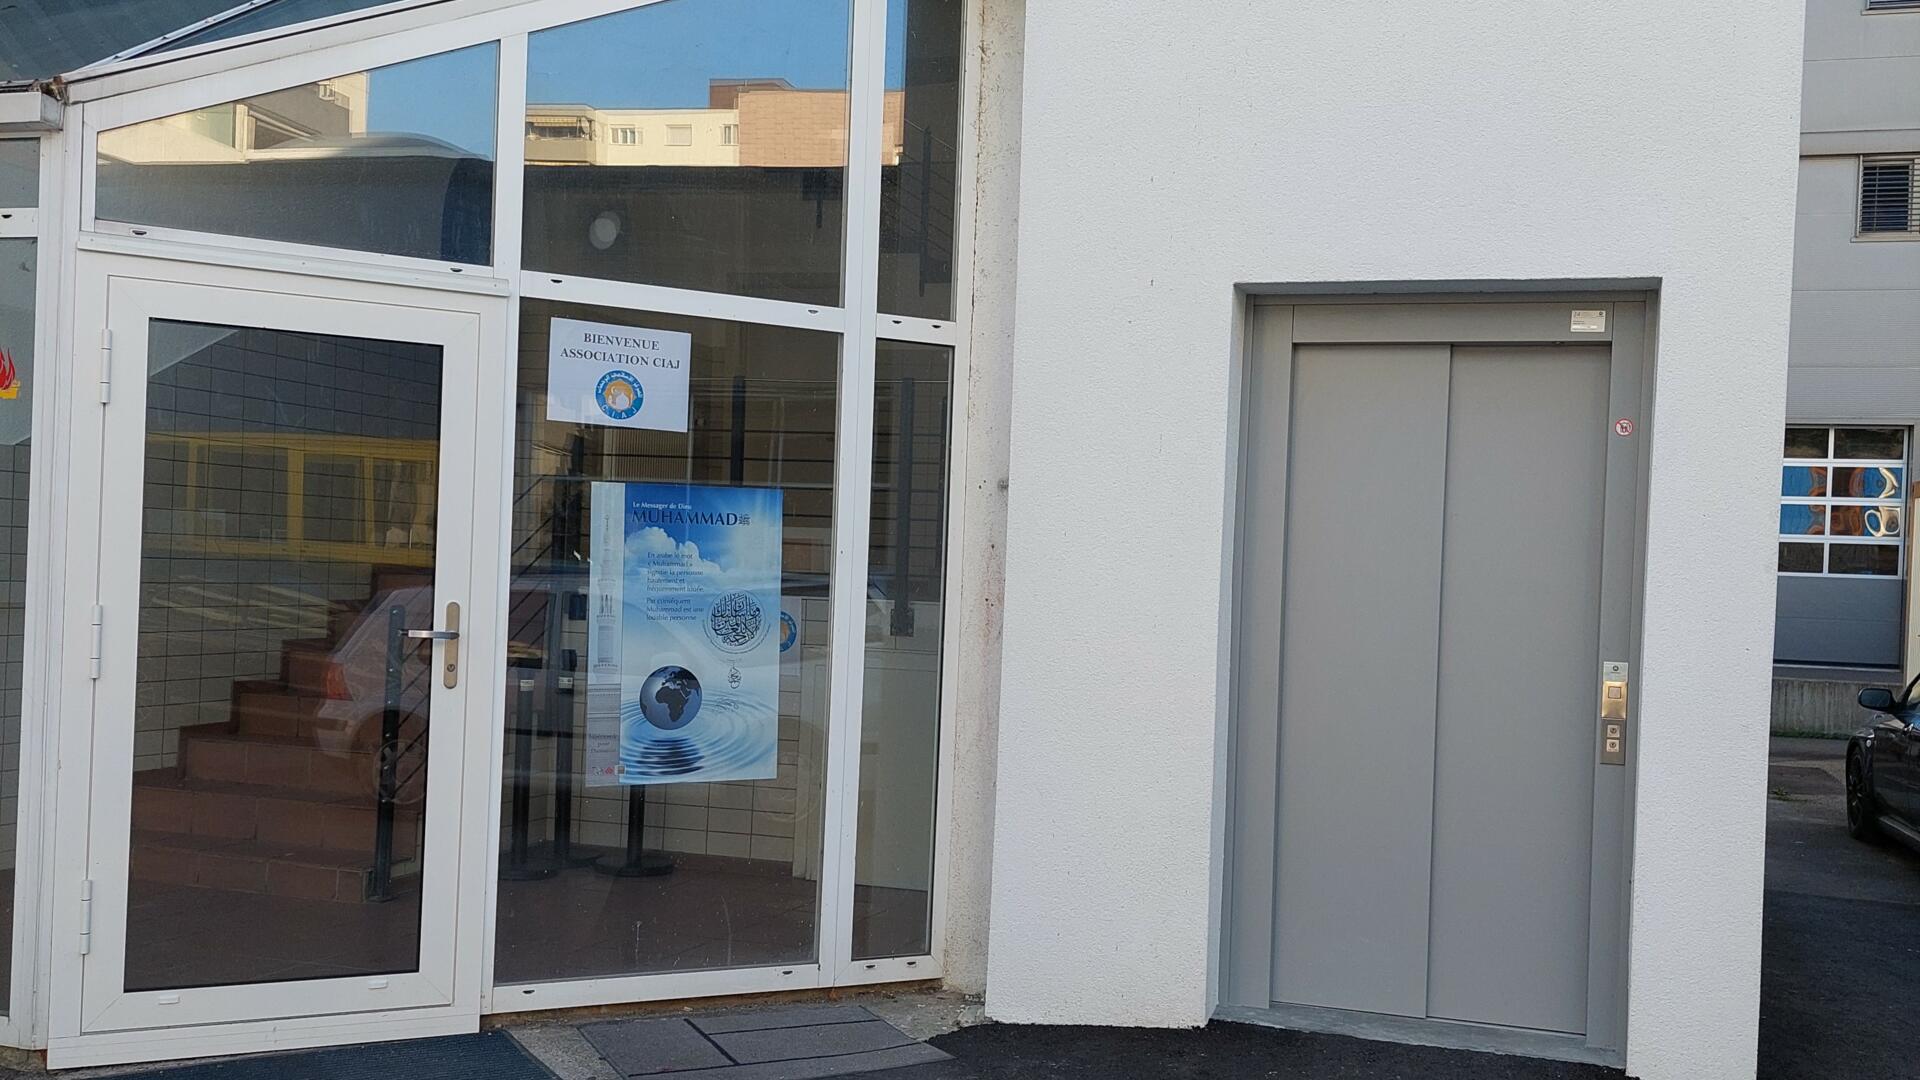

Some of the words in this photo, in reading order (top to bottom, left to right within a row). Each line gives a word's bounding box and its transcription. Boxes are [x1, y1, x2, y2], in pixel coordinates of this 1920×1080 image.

[584, 333, 660, 350] BIENVENUE
[560, 348, 649, 366] ASSOCIATION
[653, 358, 680, 369] CIAJ
[641, 501, 668, 510] Messager
[632, 510, 737, 526] MUHAMMAD
